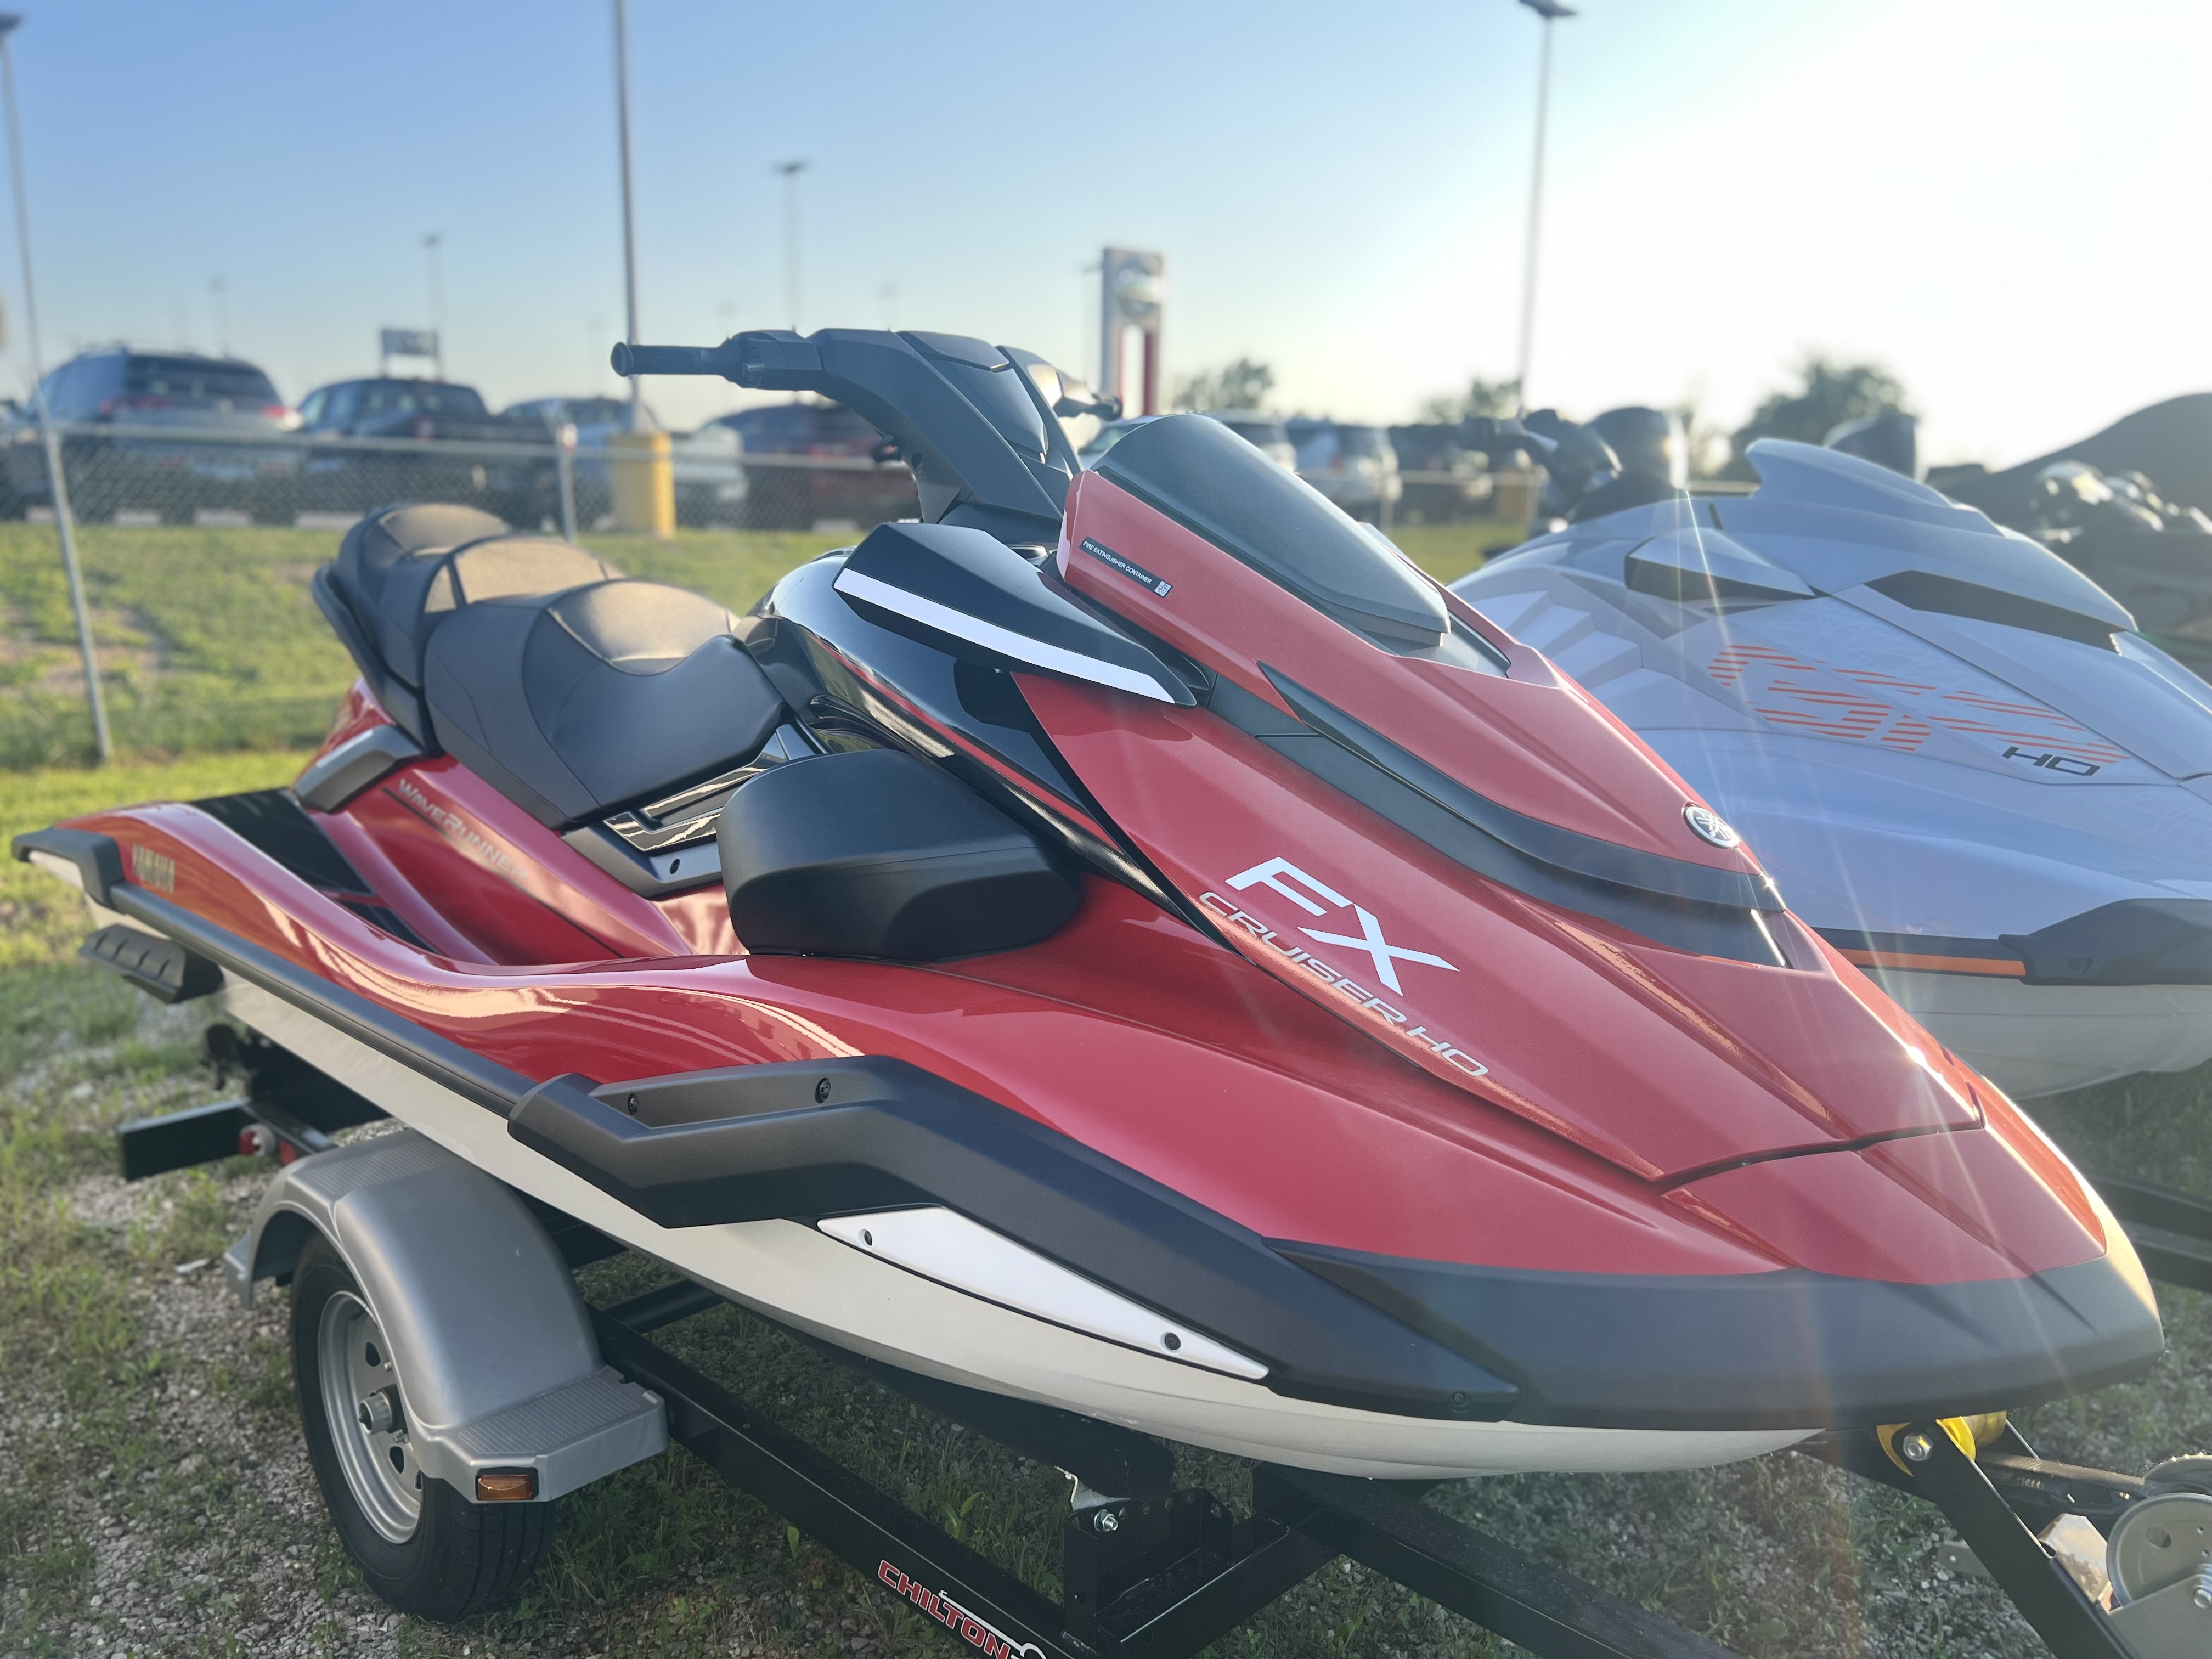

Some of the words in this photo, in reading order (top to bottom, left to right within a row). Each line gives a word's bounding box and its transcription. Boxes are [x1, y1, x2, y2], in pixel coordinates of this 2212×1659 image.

[1082, 540, 1094, 551] FIRE
[1093, 546, 1126, 569] EXTINGUISHER
[1125, 566, 1152, 584] CONTAINER
[2002, 746, 2101, 776] HO
[1224, 856, 1460, 996] FX
[1199, 891, 1407, 1025] CRUISER
[1407, 1026, 1488, 1077] HO
[878, 1560, 1011, 1659] CHILTON
